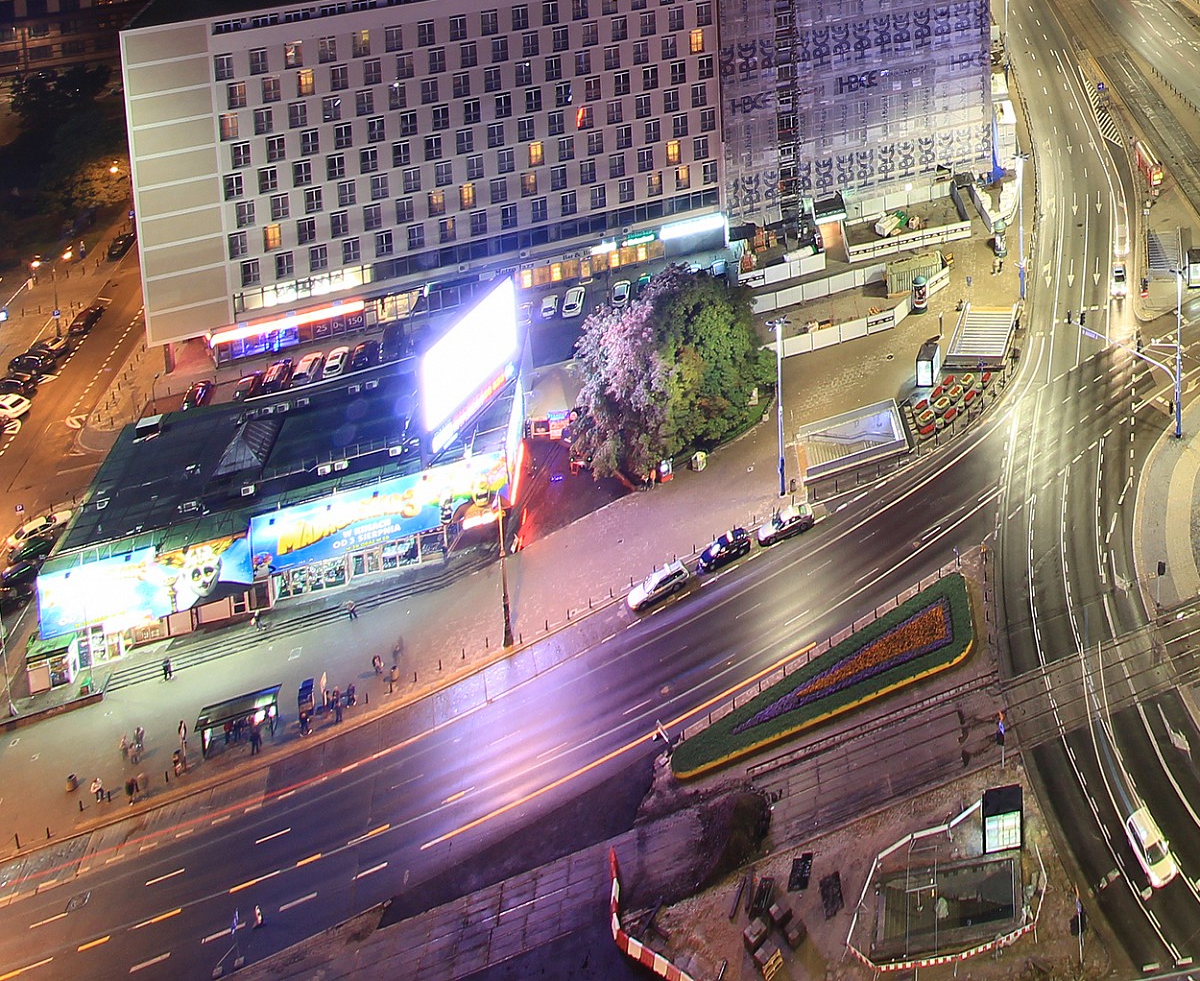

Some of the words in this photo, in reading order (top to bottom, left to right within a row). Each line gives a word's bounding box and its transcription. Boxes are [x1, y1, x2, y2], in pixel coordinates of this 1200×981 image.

[316, 324, 328, 333] 25
[348, 316, 363, 325] 150
[332, 539, 348, 549] OD
[357, 524, 402, 542] SIERPNIA
[342, 529, 352, 538] W
